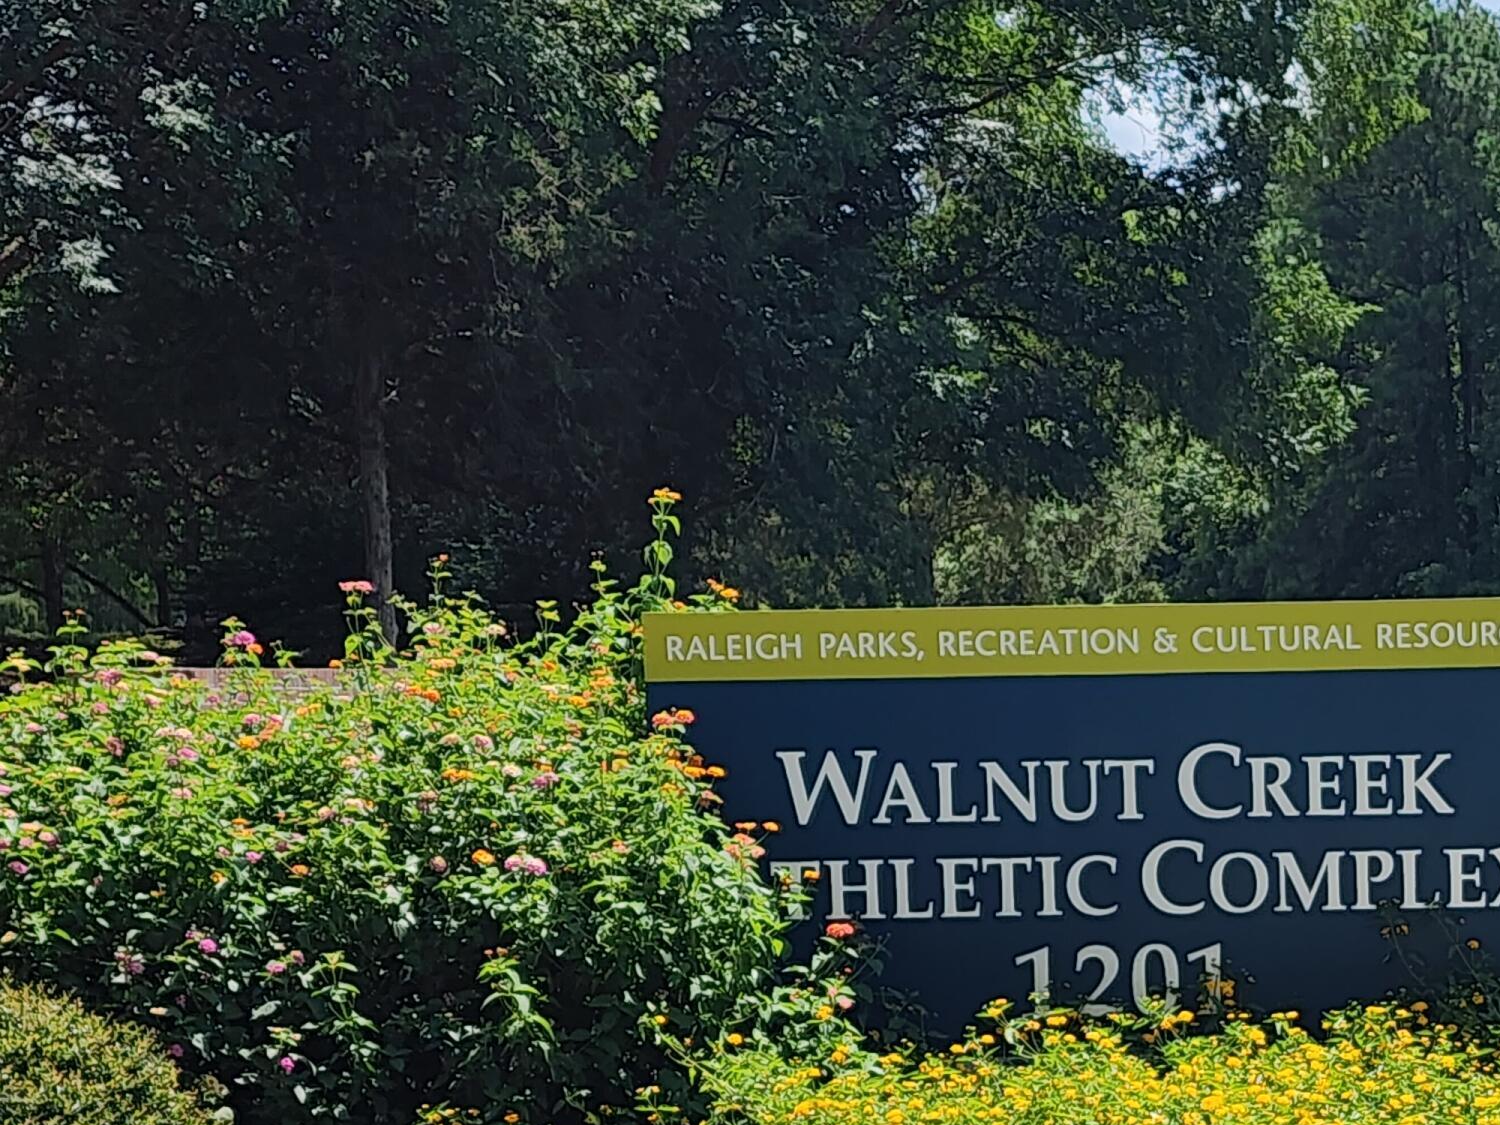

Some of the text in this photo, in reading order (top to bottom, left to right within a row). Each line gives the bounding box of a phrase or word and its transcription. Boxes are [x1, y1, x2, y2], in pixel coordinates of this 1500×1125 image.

[665, 632, 802, 662] RALEIGH
[819, 631, 925, 662] PARKS,
[938, 627, 1140, 658] RECREATION
[1153, 626, 1178, 654] &
[1191, 623, 1362, 654] CULTURAL
[775, 742, 1456, 826] WALNUT CREEK
[768, 853, 1119, 921] THLETIC
[1014, 942, 1222, 1017] 1201
